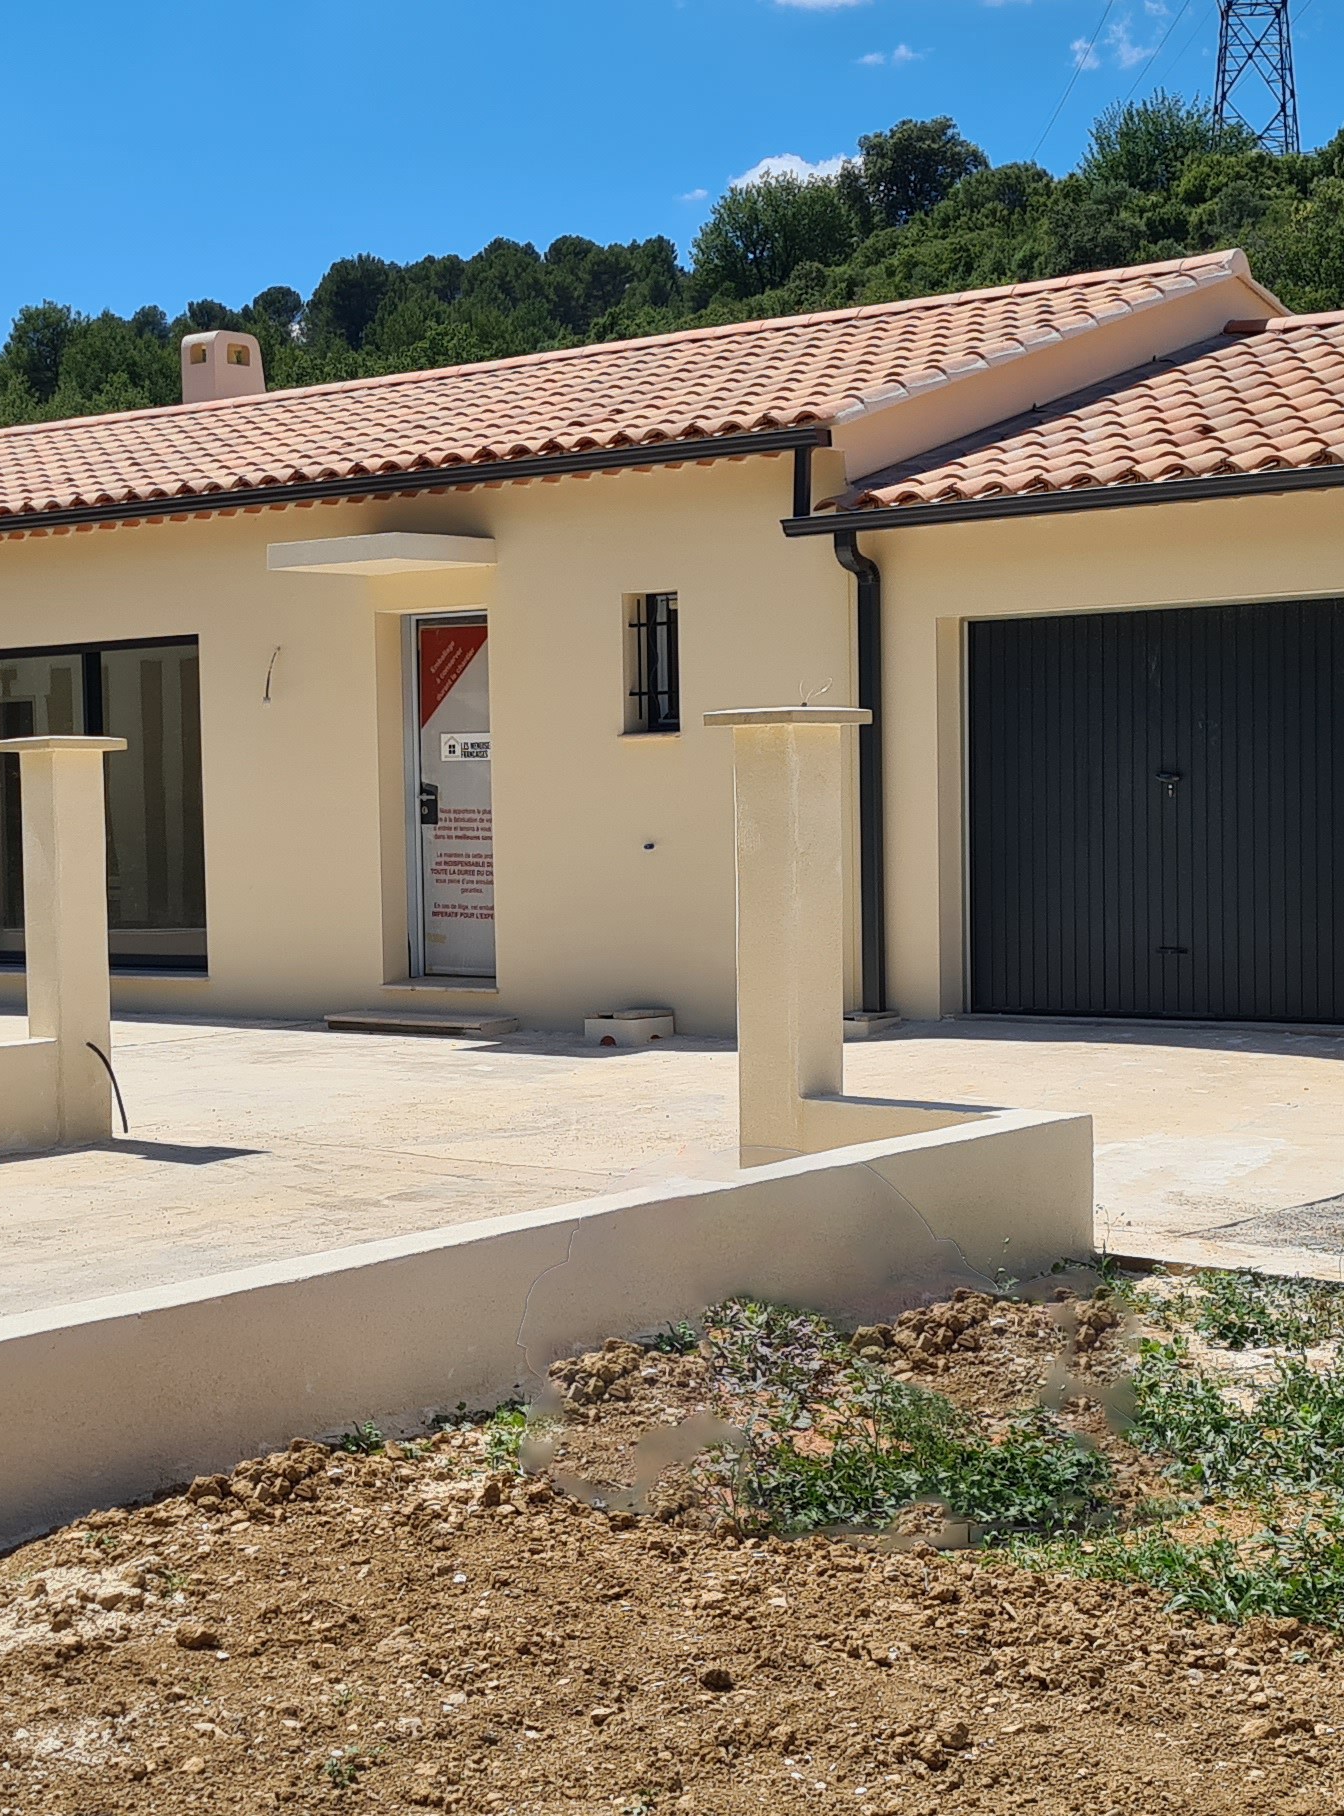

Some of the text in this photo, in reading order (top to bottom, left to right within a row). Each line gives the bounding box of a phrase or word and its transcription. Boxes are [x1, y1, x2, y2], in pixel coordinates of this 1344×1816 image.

[430, 640, 455, 674] Emballage
[456, 647, 475, 674] chantier
[439, 647, 463, 680] conserver
[460, 742, 469, 750] LES
[443, 860, 486, 868] INDISPENSABLE
[448, 868, 457, 876] LA
[476, 869, 485, 877] DU
[459, 911, 475, 919] POUR
